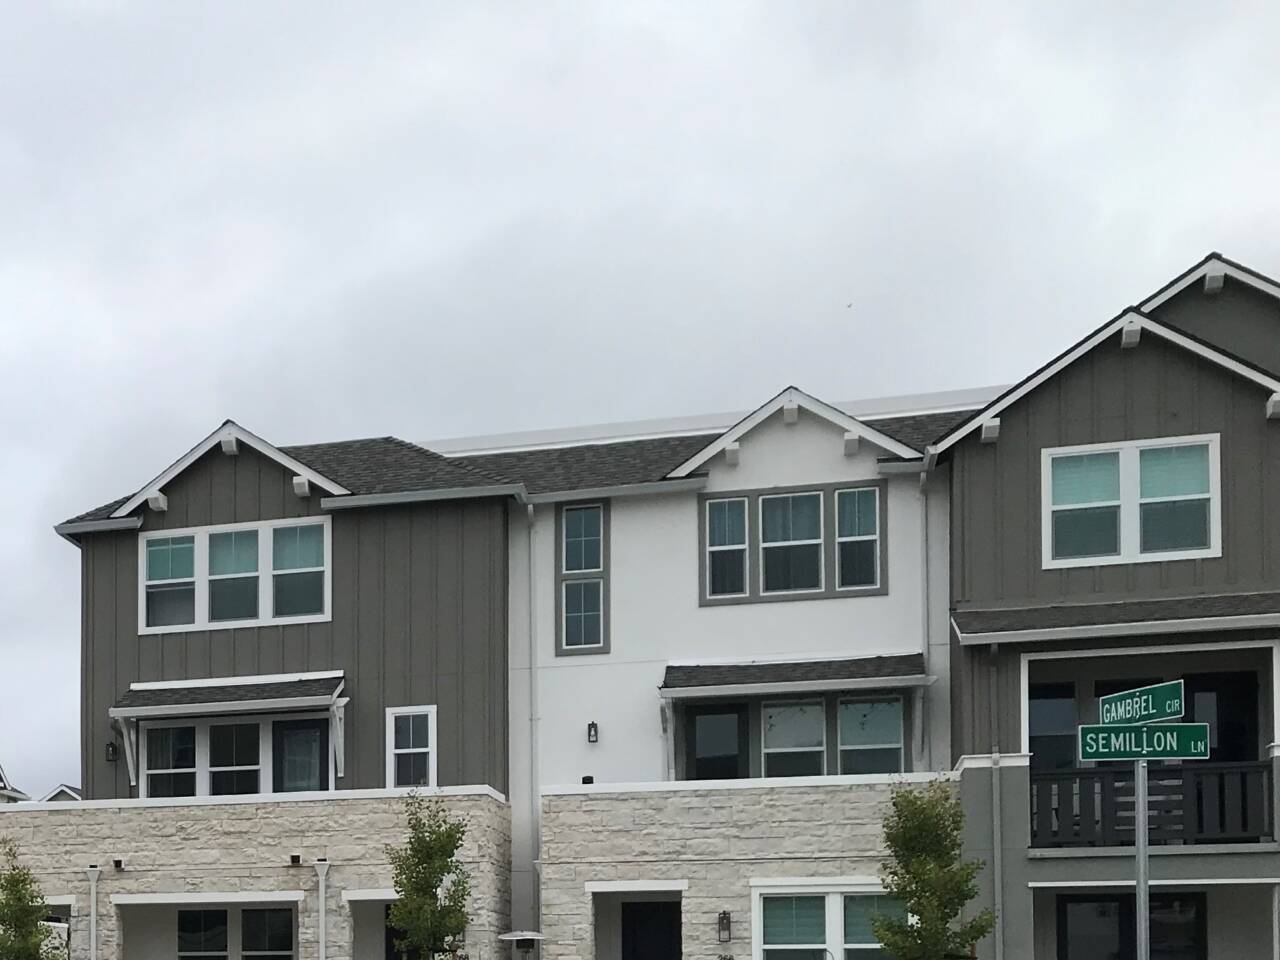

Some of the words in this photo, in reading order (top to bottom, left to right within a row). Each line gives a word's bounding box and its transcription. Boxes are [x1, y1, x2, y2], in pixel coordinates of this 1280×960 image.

[1103, 694, 1157, 723] GAMBREL
[1165, 699, 1181, 713] CIR
[1085, 731, 1178, 753] SEMILLON
[1191, 741, 1205, 753] LN
